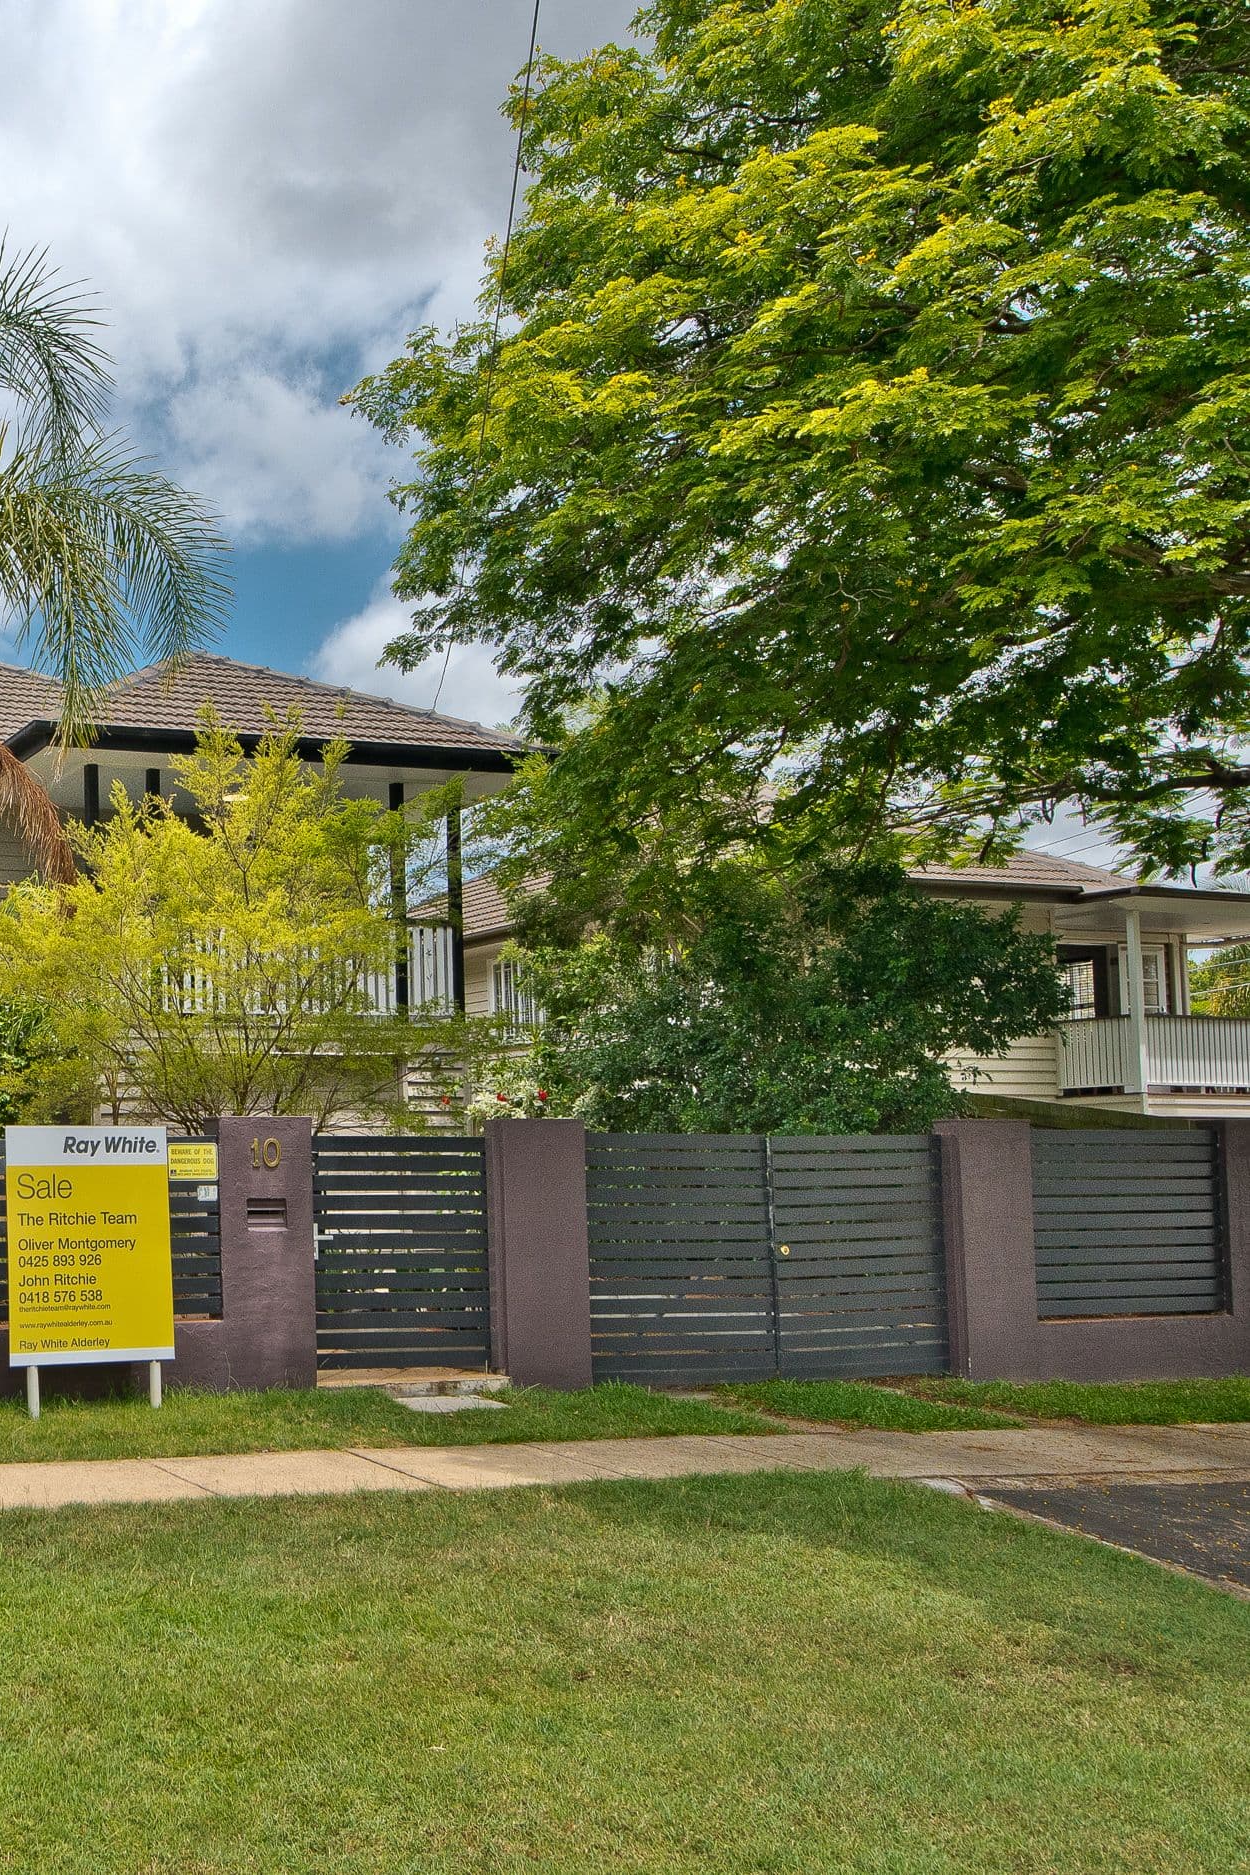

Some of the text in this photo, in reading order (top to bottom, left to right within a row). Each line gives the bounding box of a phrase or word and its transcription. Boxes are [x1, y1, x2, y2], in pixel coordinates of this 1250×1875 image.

[63, 1136, 101, 1156] Ray
[250, 1137, 282, 1169] 10
[17, 1173, 73, 1200] Sale
[17, 1211, 138, 1226] The Ritchie Team
[18, 1238, 136, 1252] Oliver Montgomery
[18, 1254, 102, 1268] 0425 893 926
[19, 1273, 97, 1287] John Ritchie
[19, 1289, 103, 1304] 0418 576 538
[19, 1320, 113, 1329] www.raywhitealderley.com.au
[19, 1337, 110, 1351] Ray White Alderley
